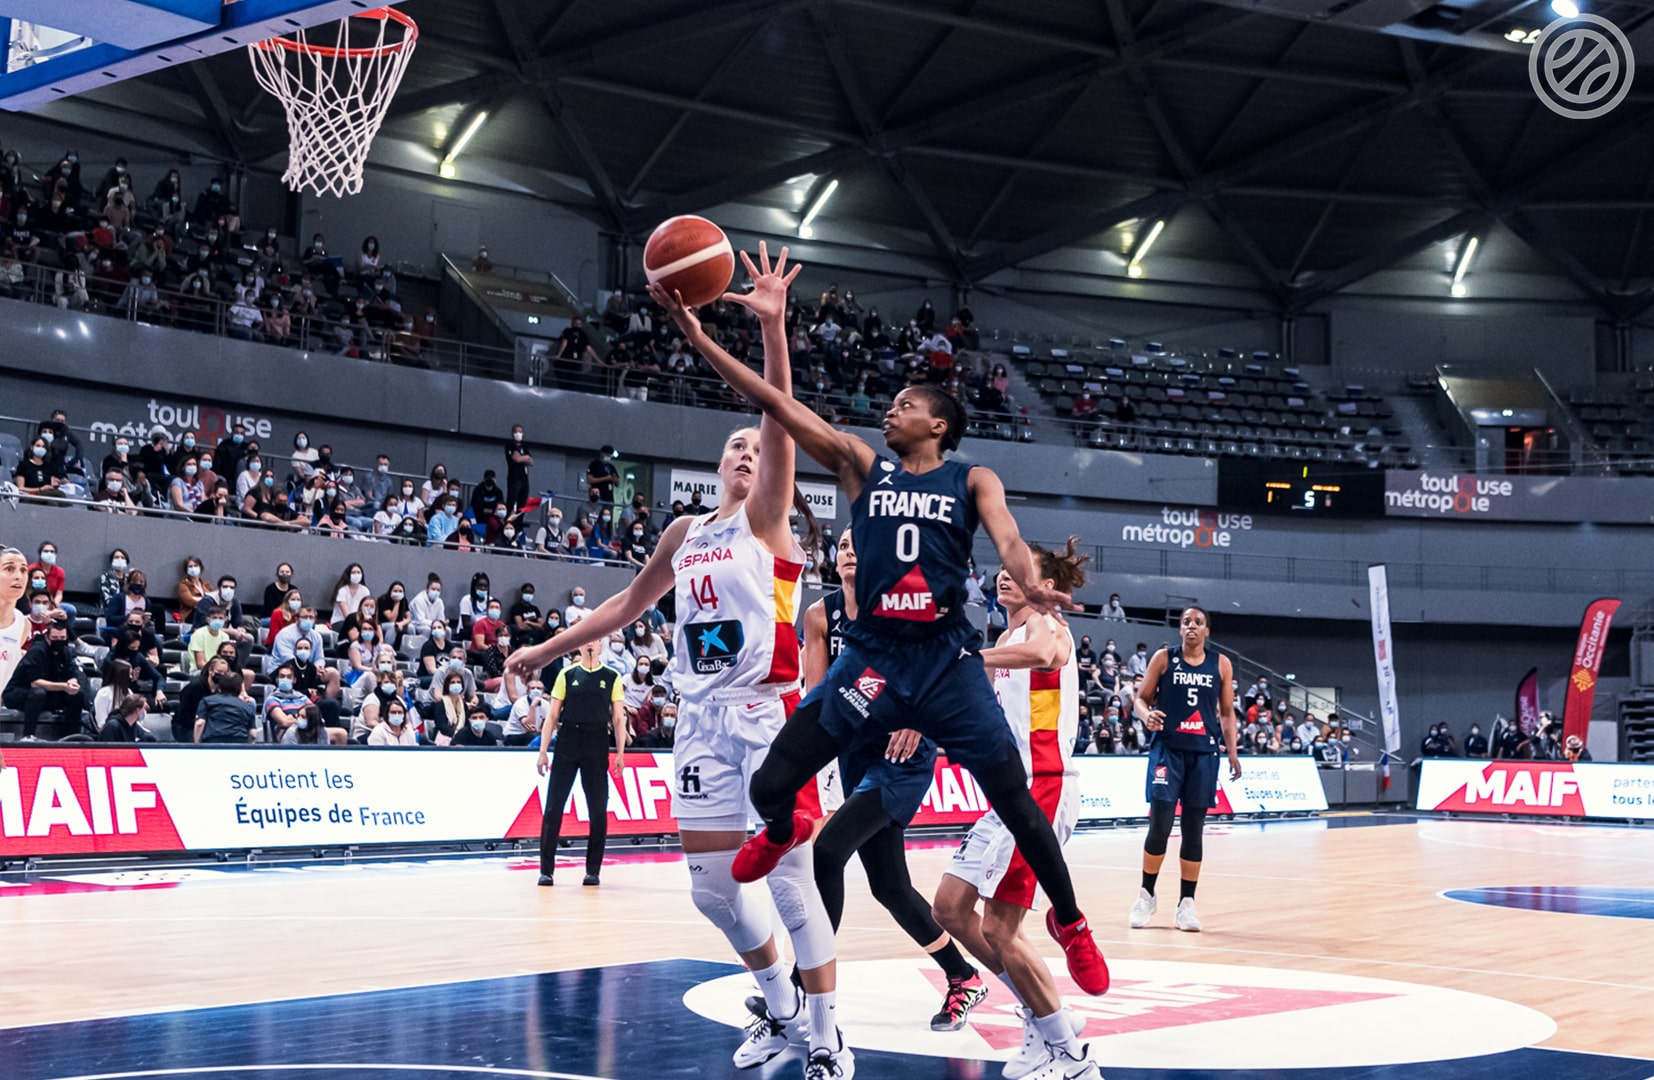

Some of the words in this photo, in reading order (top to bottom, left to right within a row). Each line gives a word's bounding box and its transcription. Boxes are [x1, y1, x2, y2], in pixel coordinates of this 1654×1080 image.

[147, 399, 272, 438] toulouse
[673, 480, 717, 496] MAIRIE
[805, 493, 833, 506] OUSE
[1420, 473, 1512, 496] toulouse
[868, 490, 955, 524] FRANCE
[1161, 506, 1252, 530] toulouse
[896, 523, 920, 562] 0
[678, 547, 733, 571] ESPAÑA
[690, 575, 719, 611] 14
[881, 592, 933, 611] MAIF
[1582, 610, 1605, 668] Occitanie
[1173, 672, 1213, 688] FRANCE
[1187, 687, 1199, 707] 5
[1180, 721, 1205, 730] MAIF
[230, 768, 320, 789] soutient
[324, 768, 354, 789] les
[1465, 770, 1578, 806] MAIF
[1612, 794, 1643, 805] tous
[1647, 793, 1654, 805] l
[235, 796, 322, 829] Équipes
[328, 803, 353, 823] de
[359, 806, 426, 826] France
